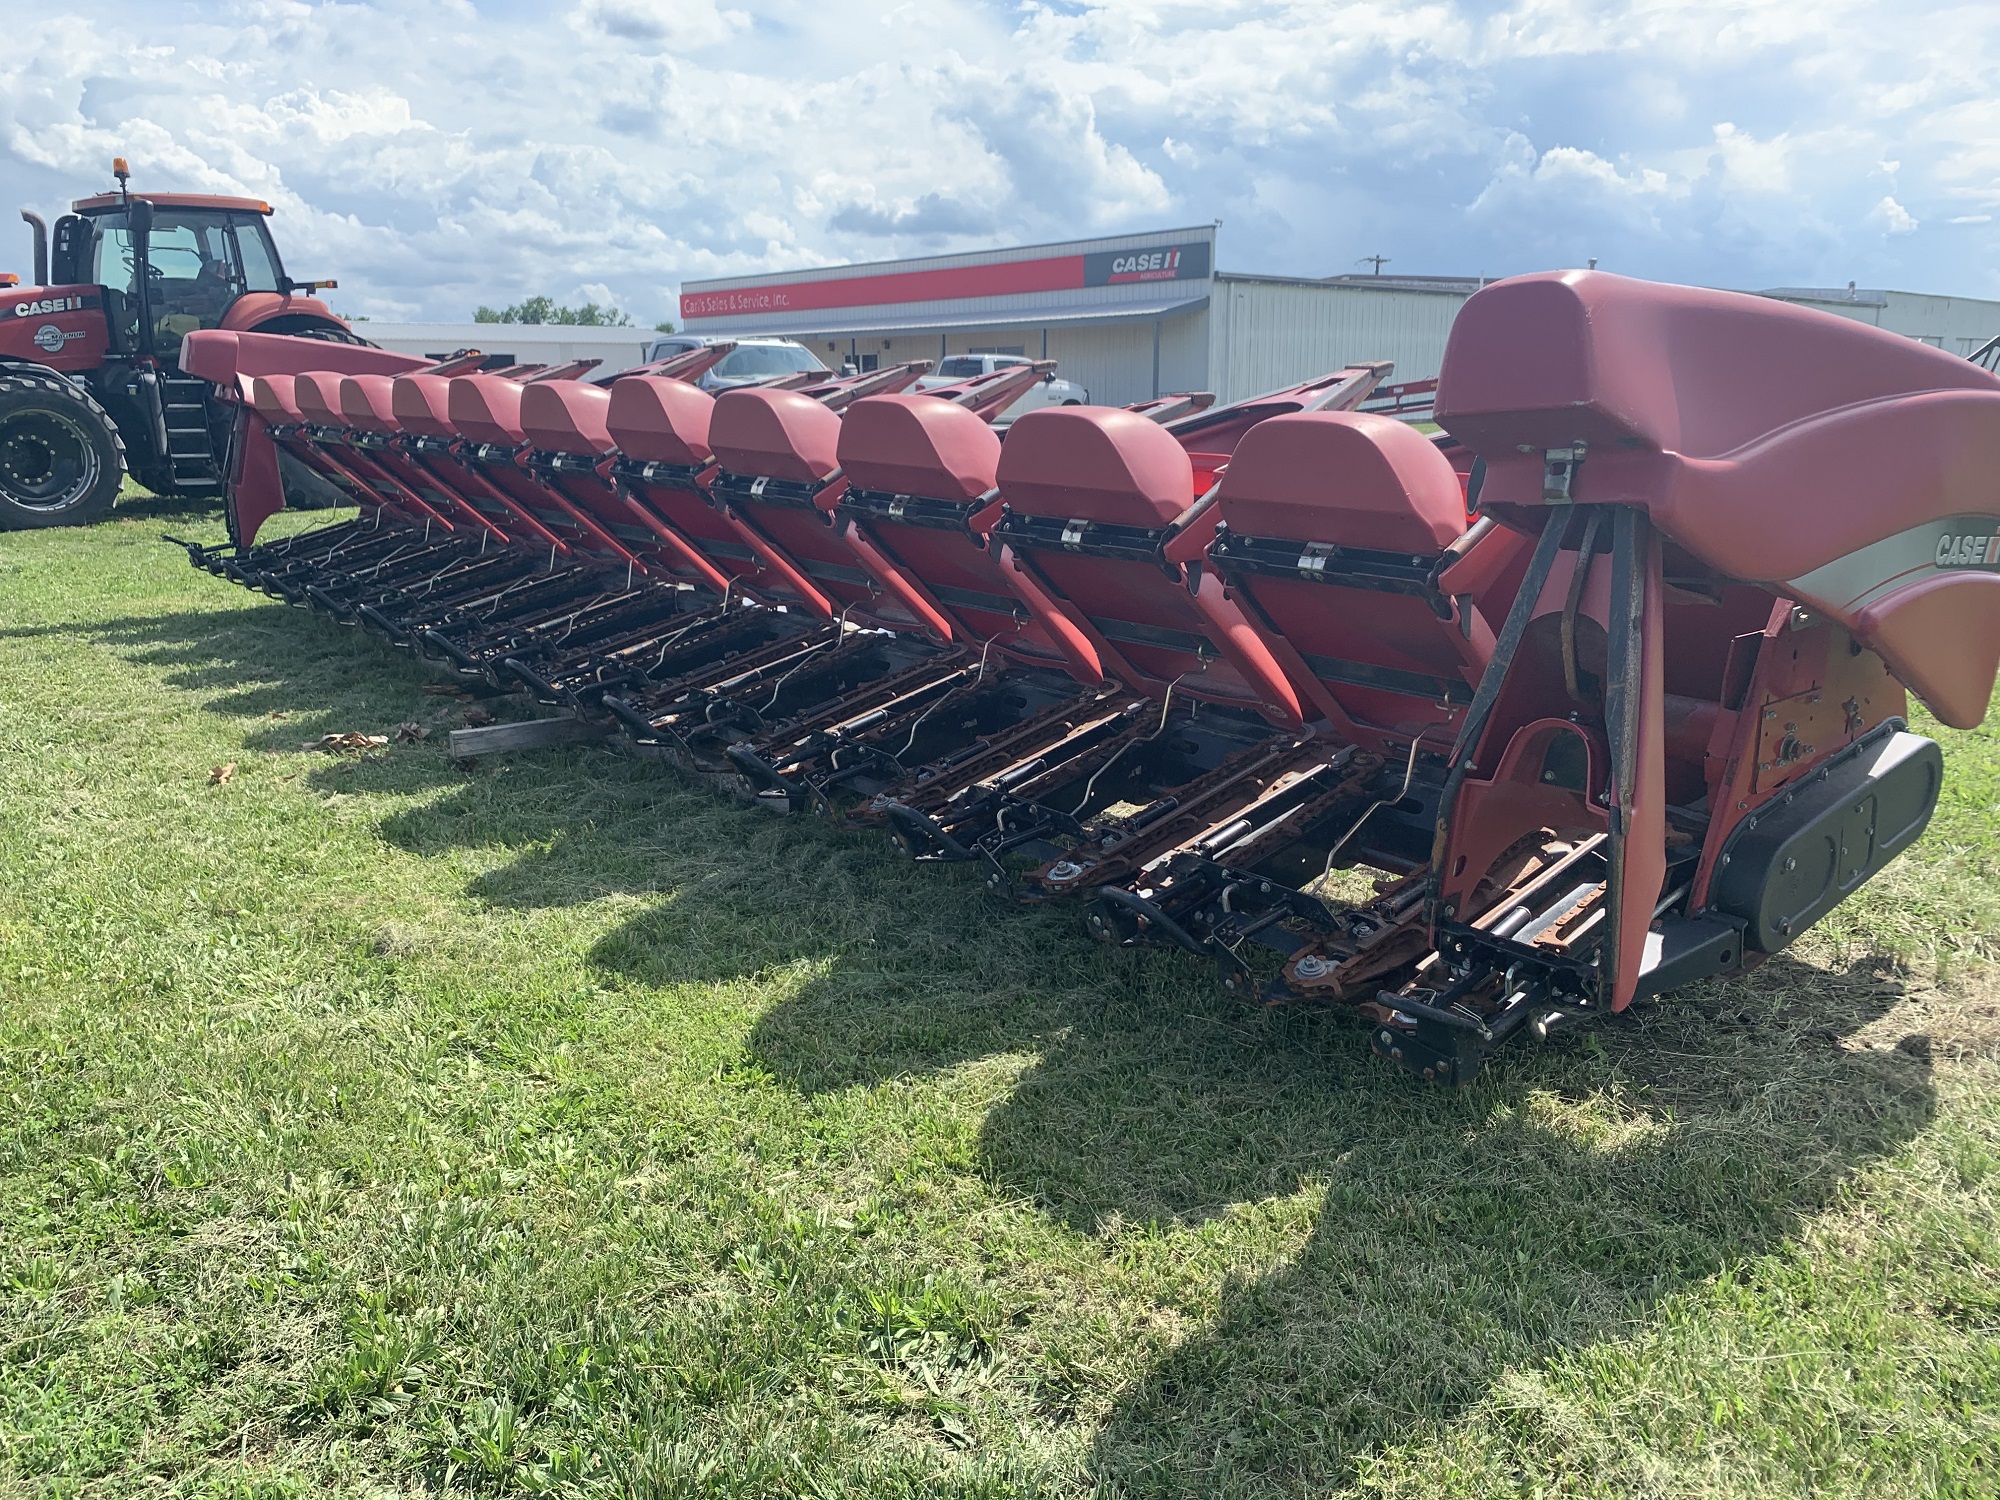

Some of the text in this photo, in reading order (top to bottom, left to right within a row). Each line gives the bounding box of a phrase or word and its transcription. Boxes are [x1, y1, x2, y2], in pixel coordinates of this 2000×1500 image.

[1112, 253, 1162, 273] CASE
[15, 298, 65, 317] CASE
[706, 296, 728, 312] Sales
[730, 295, 737, 310] &
[737, 292, 771, 310] Service,
[773, 293, 790, 307] Inc.
[51, 331, 85, 341] MAGNUM
[1935, 534, 1987, 566] CASE
